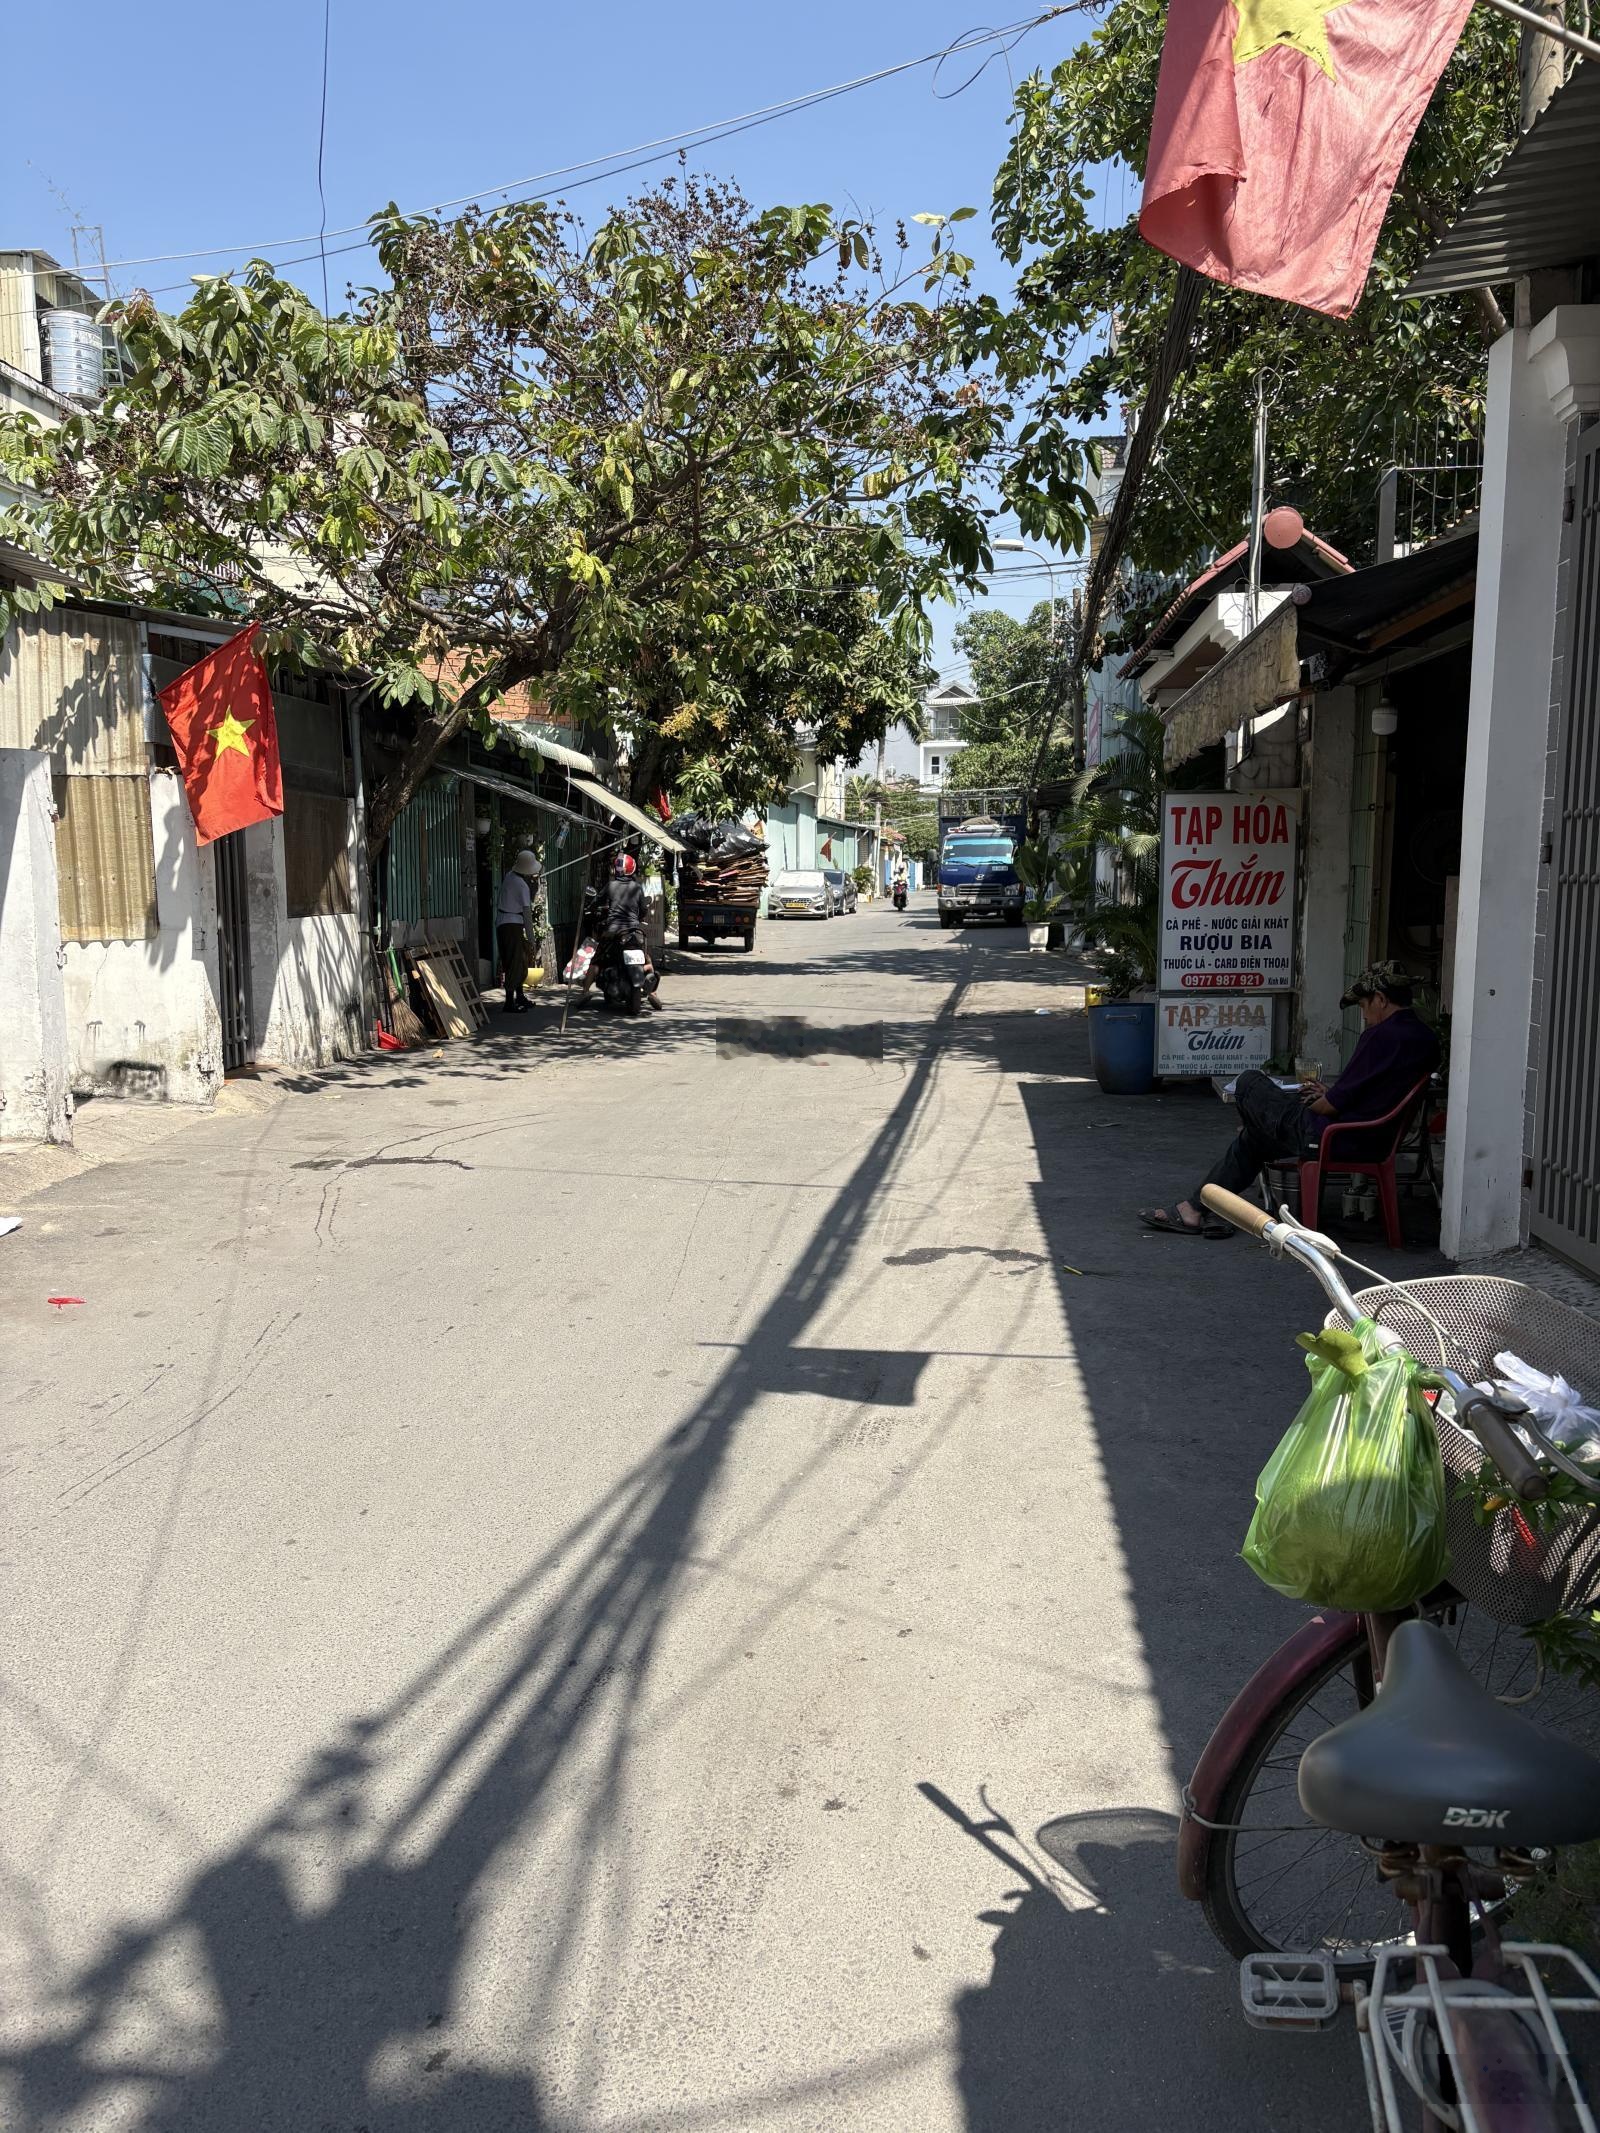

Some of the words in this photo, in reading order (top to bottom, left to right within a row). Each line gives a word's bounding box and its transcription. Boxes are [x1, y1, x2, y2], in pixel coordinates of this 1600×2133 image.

[1170, 806, 1223, 854] TẠP
[1232, 795, 1289, 844] HÓA
[1170, 853, 1286, 909] Thắm
[1182, 916, 1201, 930] PHÊ
[1211, 915, 1238, 929] NƯỚC
[1241, 915, 1260, 929] GIẢI
[1264, 915, 1289, 929] KHÁT
[1180, 932, 1233, 954] RƯỢU
[1240, 934, 1273, 950] BIA
[1163, 954, 1192, 969] THUỐC
[1195, 955, 1206, 968] LÁ
[1214, 957, 1238, 968] CARD
[1240, 955, 1260, 970] ĐIỆN
[1263, 957, 1289, 971] THOẠI
[1185, 975, 1212, 986] 0977
[1215, 975, 1237, 986] 987
[1240, 975, 1260, 985] 921
[1164, 1004, 1210, 1031] TẠP
[1218, 1000, 1266, 1027] HÓA
[1187, 1028, 1246, 1051] Thắm
